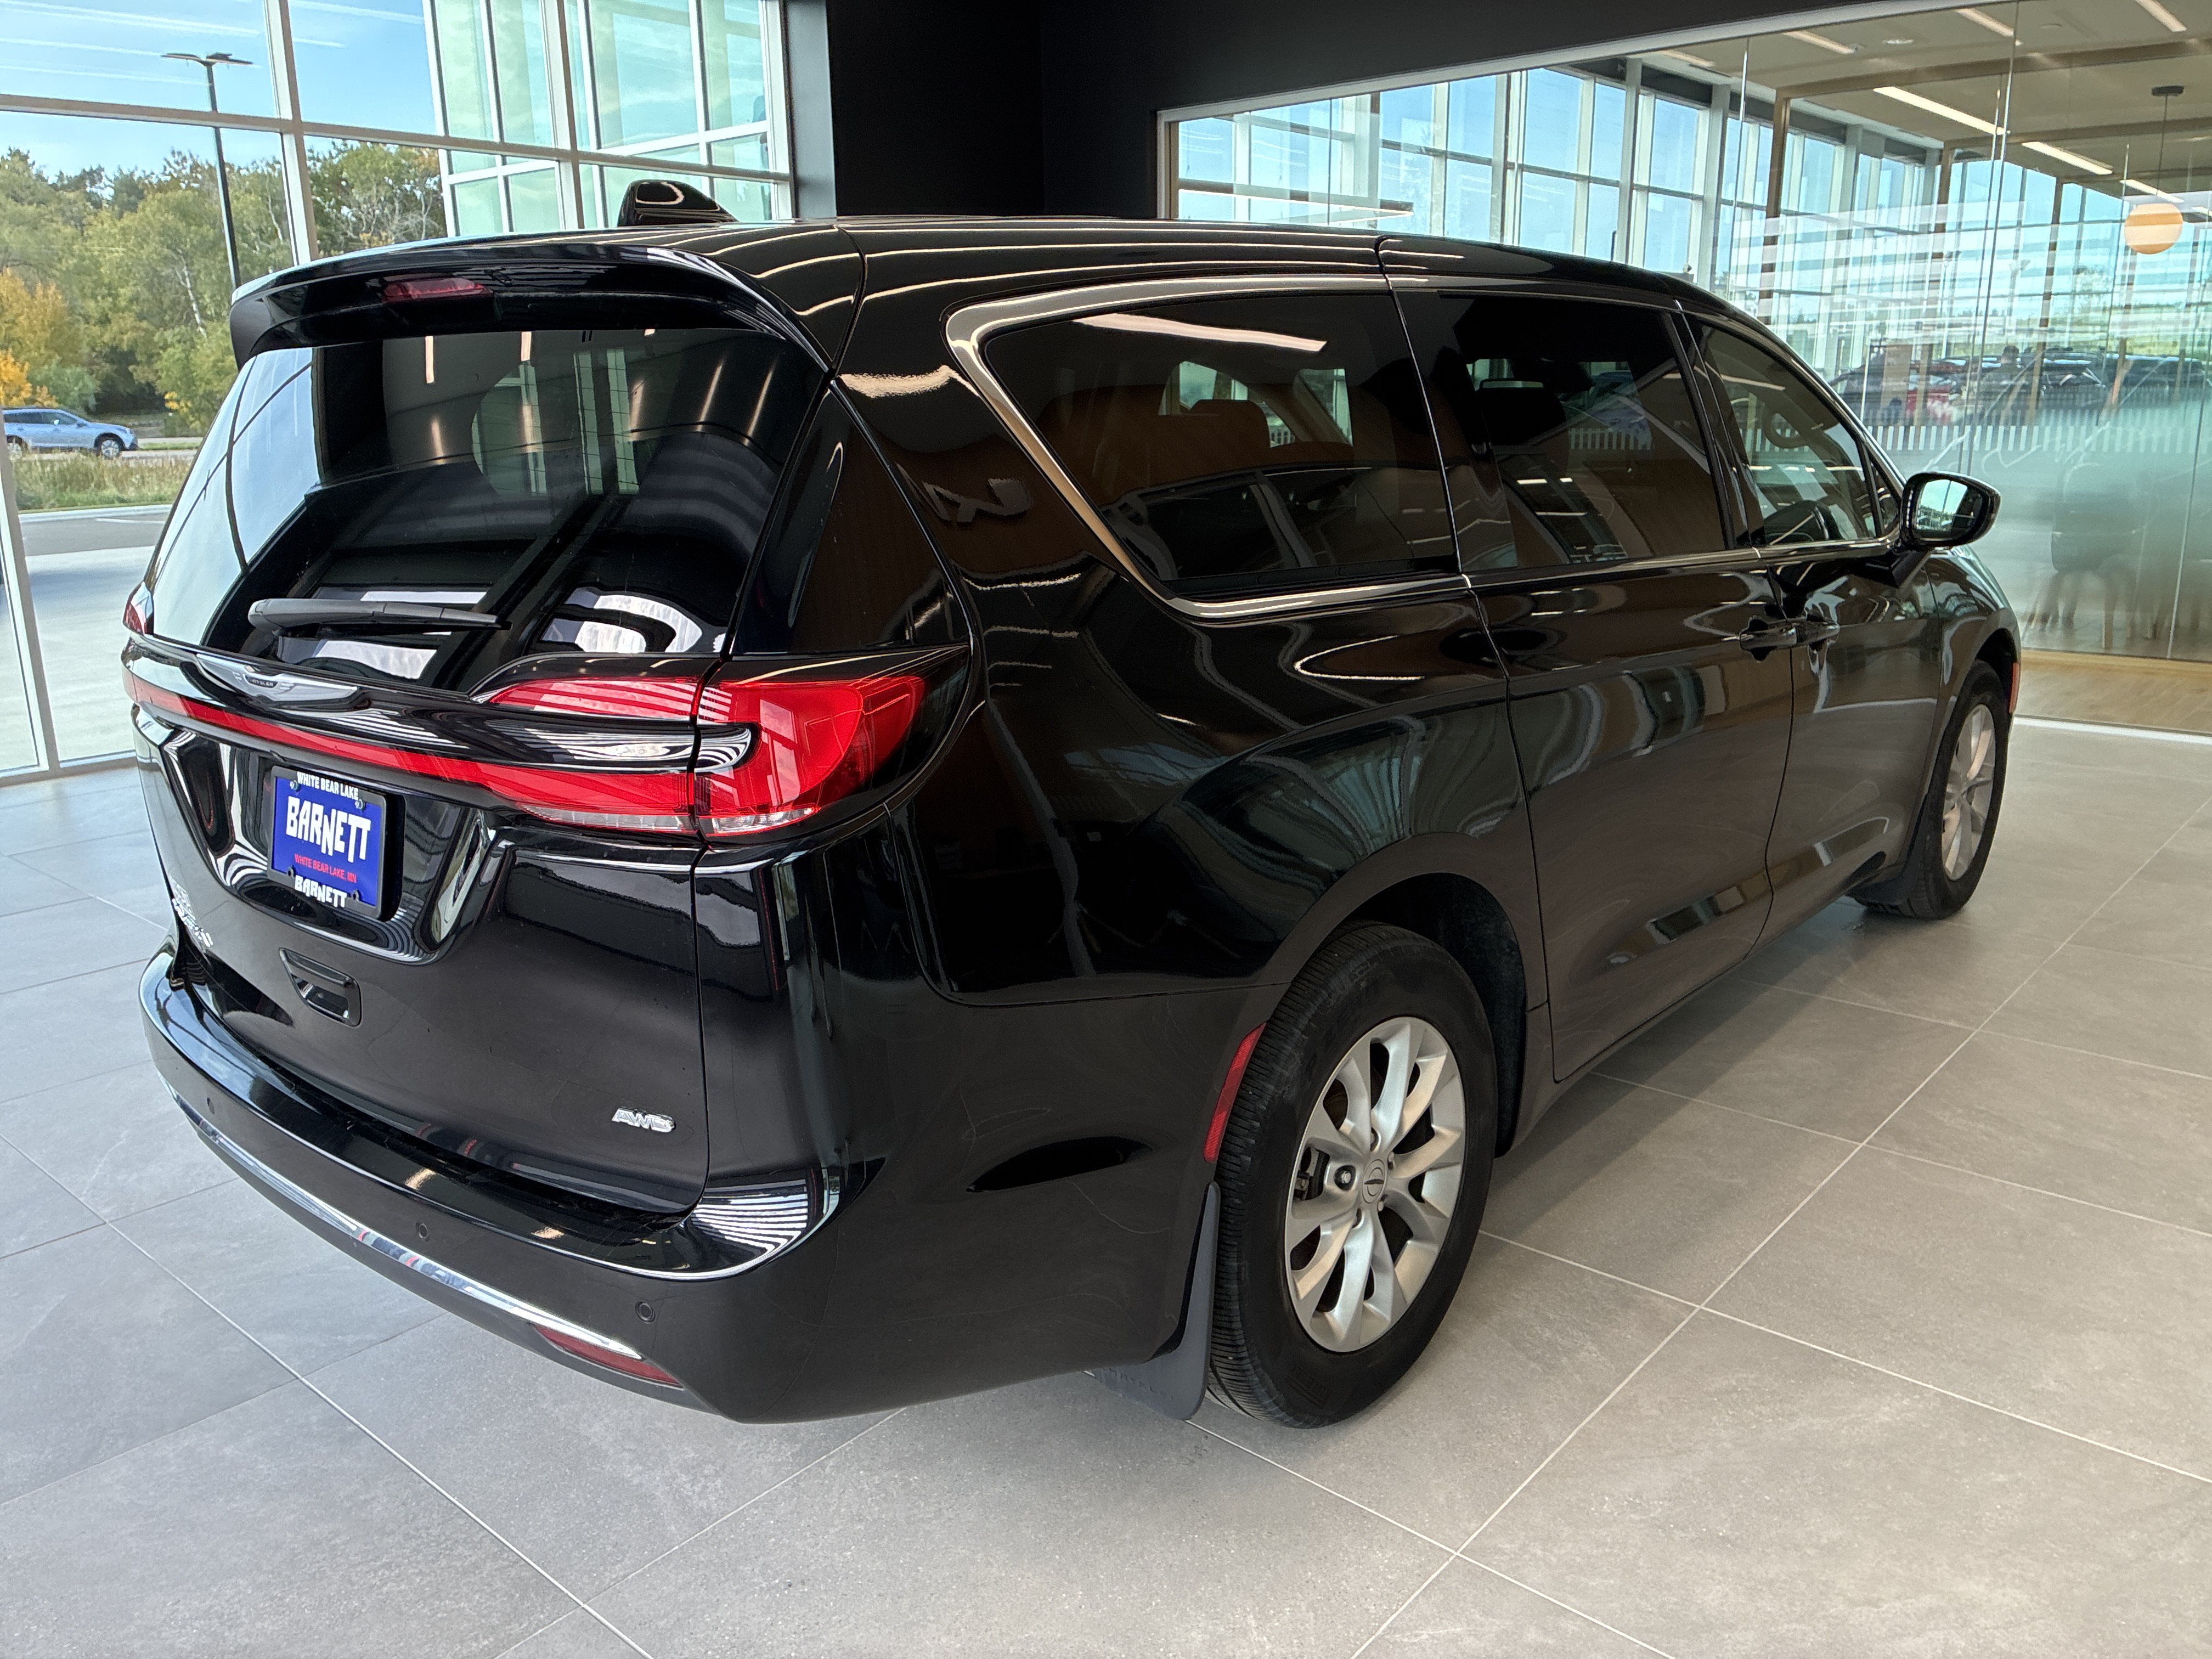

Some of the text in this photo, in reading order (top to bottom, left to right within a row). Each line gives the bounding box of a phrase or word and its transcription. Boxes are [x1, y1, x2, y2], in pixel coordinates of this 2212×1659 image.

[297, 771, 359, 800] WHITE BEAR LAKE
[286, 795, 371, 864] BARNETT
[294, 853, 312, 868] WHITE
[313, 859, 329, 874] BEAR
[329, 865, 346, 881] LAKE,
[294, 874, 347, 908] BARNETT
[611, 1107, 676, 1133] AWD
